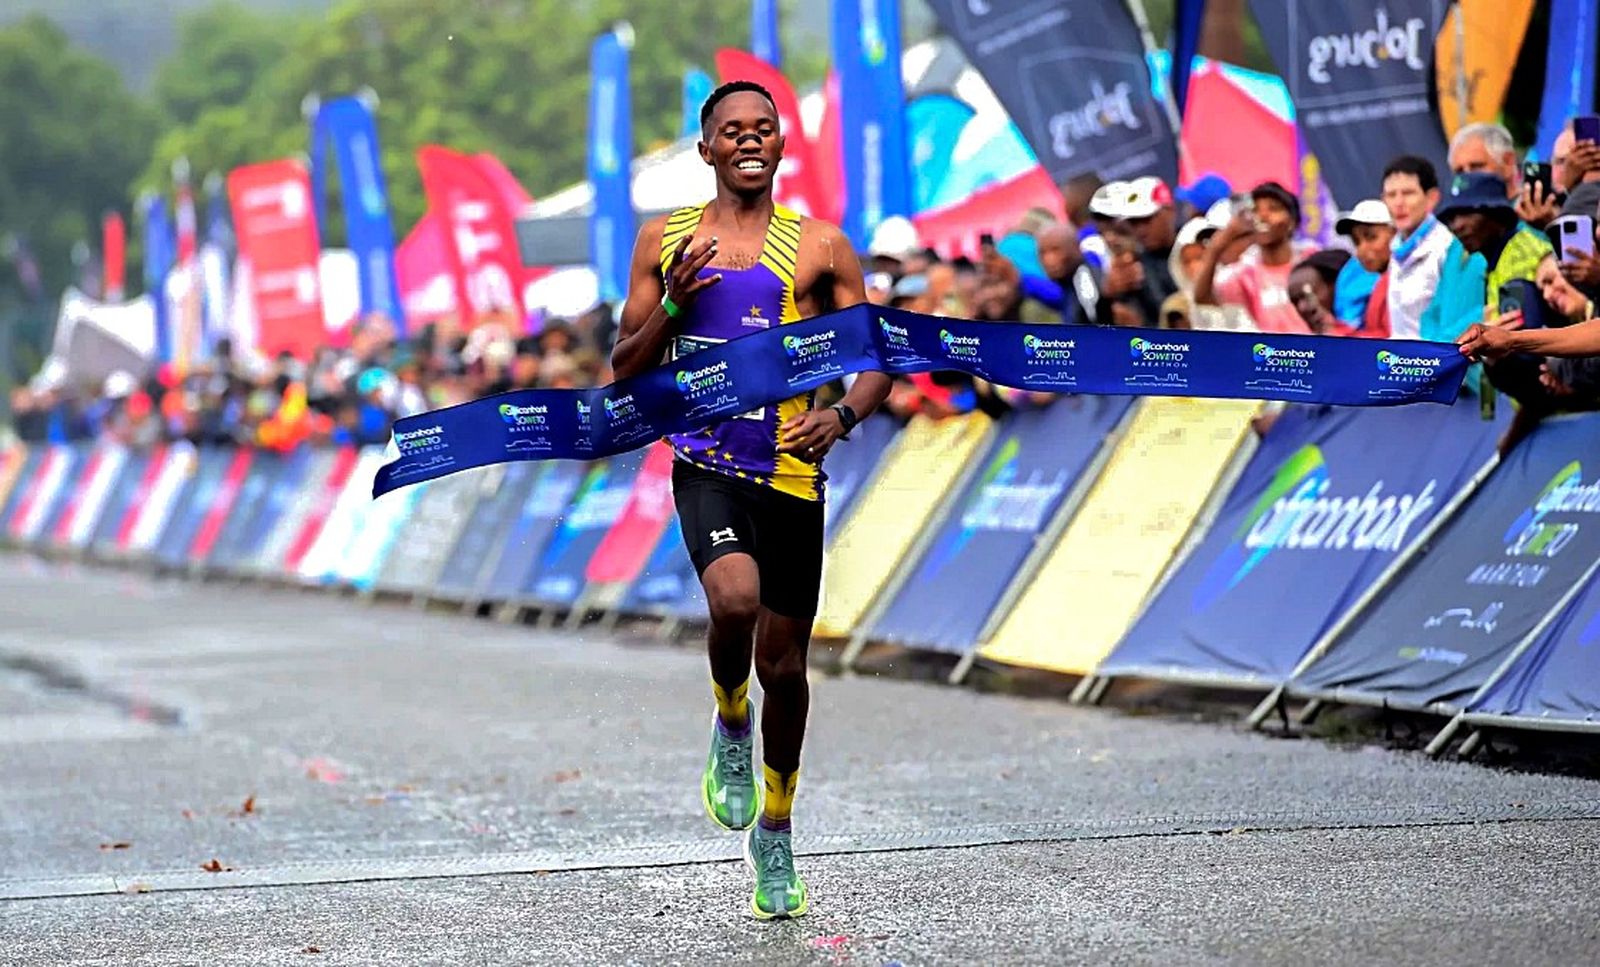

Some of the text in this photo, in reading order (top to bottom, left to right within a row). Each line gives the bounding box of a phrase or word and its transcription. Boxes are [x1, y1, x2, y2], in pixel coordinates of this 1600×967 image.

[1028, 339, 1075, 350] africanbank
[1135, 340, 1190, 352] africanbank
[1035, 350, 1071, 359] SOWETO
[1143, 352, 1184, 361] SOWETO
[1259, 346, 1315, 359] africanbank
[1266, 358, 1309, 368] SOWETO
[1383, 354, 1441, 367] africanbank
[1254, 366, 1313, 375] MARATHON
[1390, 366, 1434, 376] SOWETO
[690, 373, 725, 391] SOWETO
[1378, 375, 1437, 383] MARATHON
[401, 443, 449, 457] ARATHON
